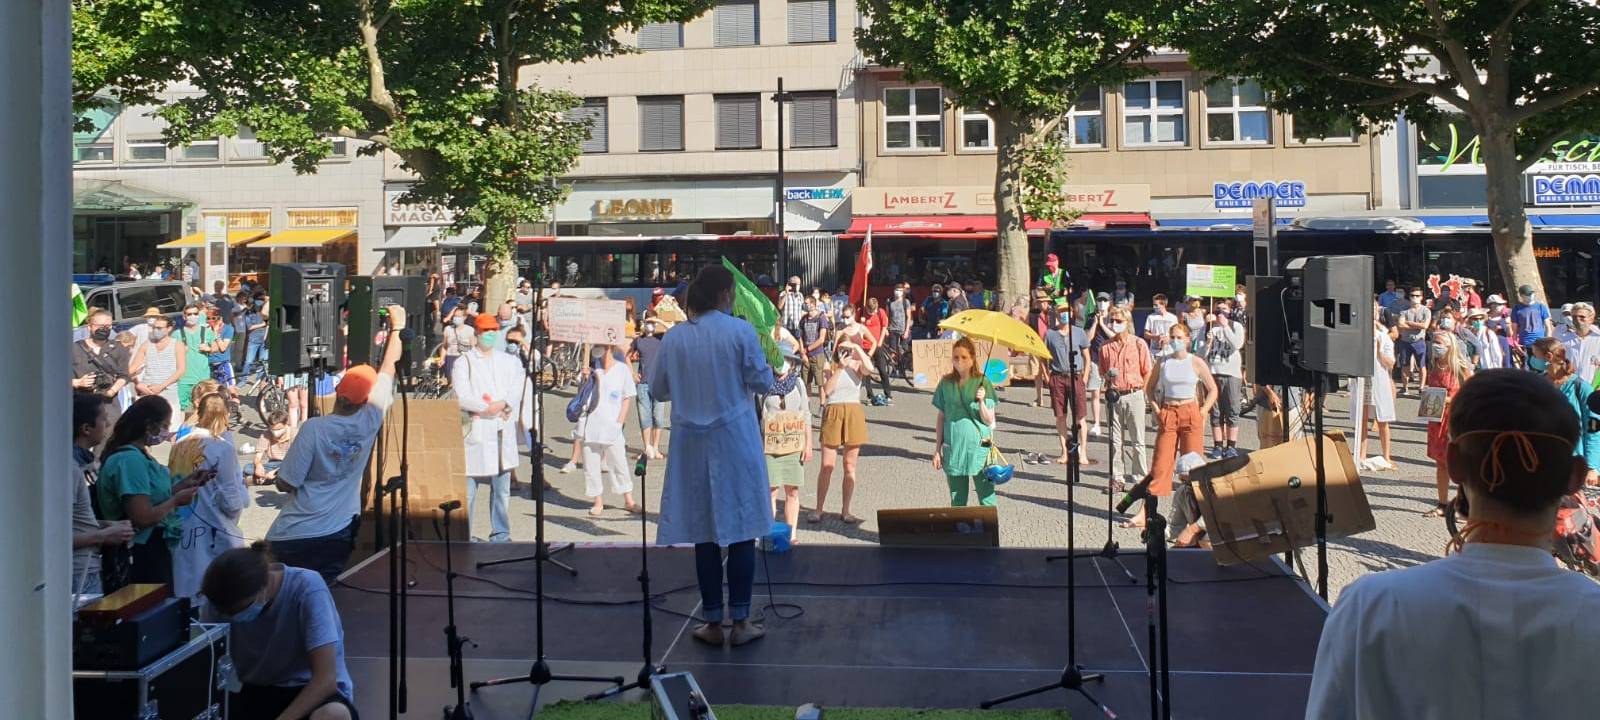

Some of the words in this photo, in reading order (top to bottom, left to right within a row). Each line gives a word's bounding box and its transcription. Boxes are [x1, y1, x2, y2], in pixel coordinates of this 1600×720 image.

[1066, 190, 1117, 206] BERTZ
[1215, 182, 1304, 199] DEMMER
[595, 199, 673, 216] LEONE
[884, 192, 957, 208] LAMBERTZ
[392, 213, 447, 222] MAGA
